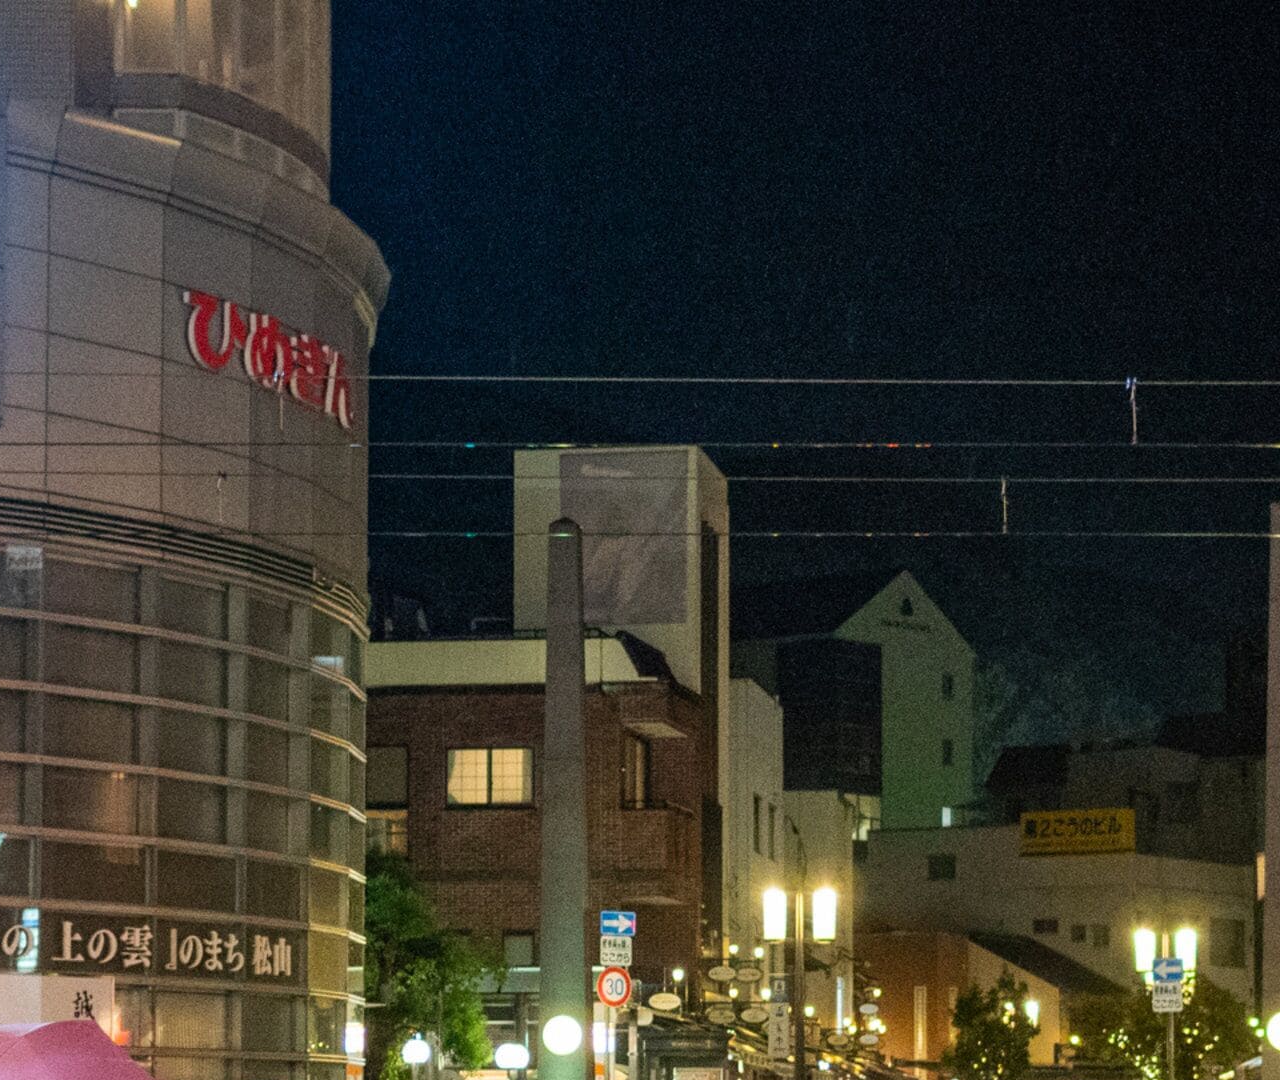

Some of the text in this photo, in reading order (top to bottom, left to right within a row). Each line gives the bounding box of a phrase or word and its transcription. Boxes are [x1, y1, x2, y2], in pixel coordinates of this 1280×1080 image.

[183, 289, 355, 429] ひめぎん
[606, 977, 624, 996] 30
